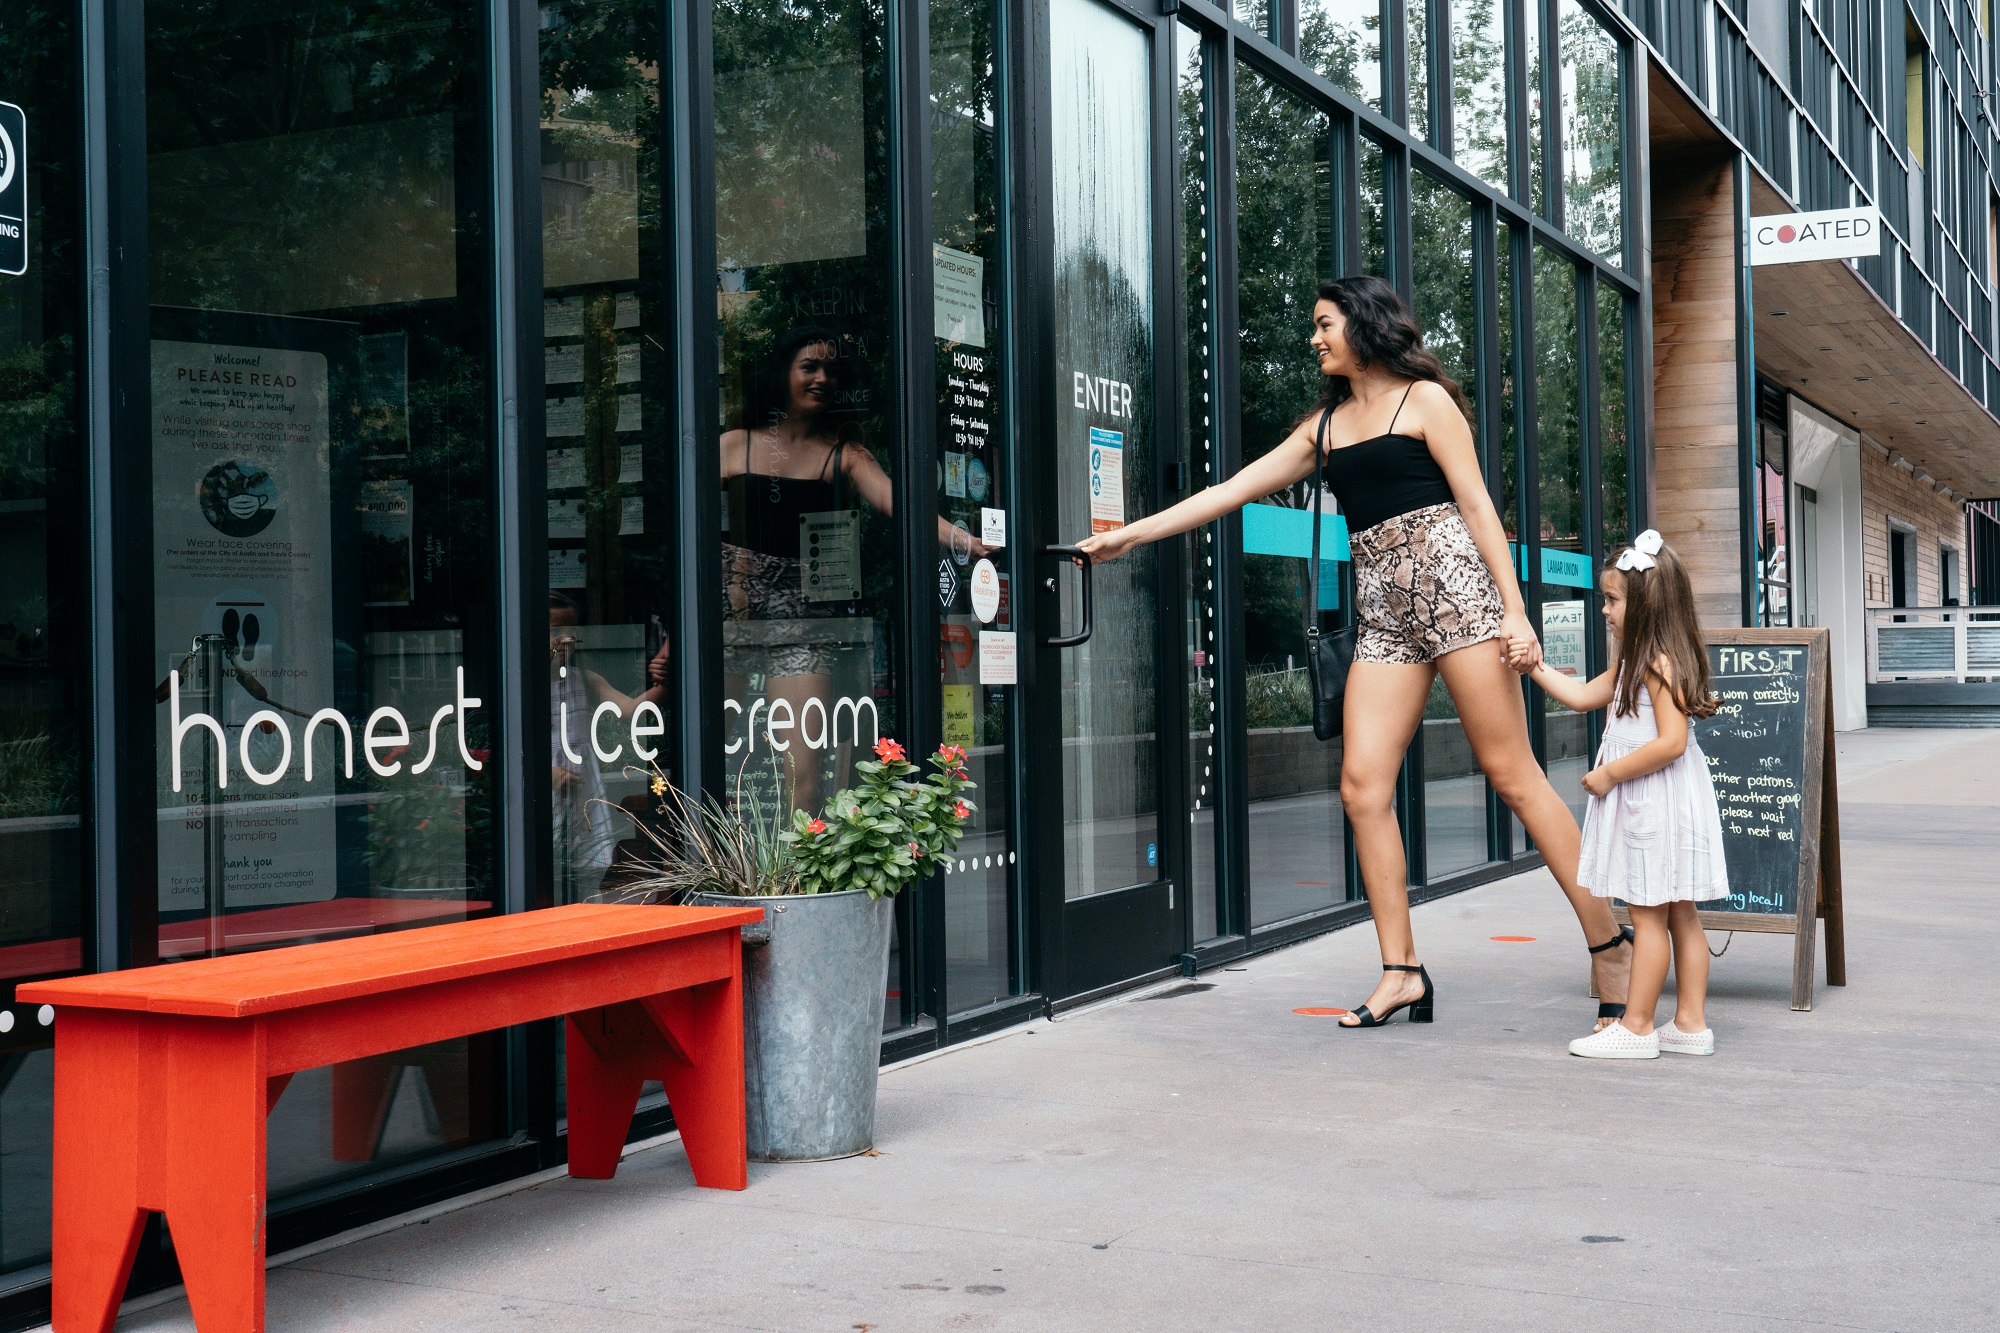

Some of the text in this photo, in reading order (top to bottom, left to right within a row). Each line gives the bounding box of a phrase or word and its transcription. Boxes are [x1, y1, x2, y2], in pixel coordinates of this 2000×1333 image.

[935, 258, 956, 272] UPDATED
[214, 354, 261, 368] Welcome!
[953, 352, 984, 373] HOURS
[178, 368, 296, 388] PLEASE READ
[948, 374, 965, 392] Sunday
[968, 378, 989, 398] Thursday
[834, 389, 871, 404] SINCE
[1073, 370, 1132, 419] ENTER
[228, 400, 245, 408] ALL
[162, 414, 311, 434] While visiting our scoop shop
[950, 413, 965, 430] Friday
[162, 426, 196, 439] during
[200, 428, 227, 438] these
[231, 430, 280, 441] uncertain
[192, 441, 208, 450] we
[211, 441, 228, 451] ask
[232, 441, 252, 452] that
[368, 501, 406, 512] 400,000
[186, 538, 292, 552] Wear face covering
[1546, 560, 1579, 577] LAMAR UNION
[1720, 648, 1803, 675] FIRST
[261, 667, 308, 682] line/rope
[1723, 686, 1800, 704] worn correctly
[170, 666, 880, 793] honest ice cream
[1712, 772, 1797, 789] other patrons.
[186, 790, 299, 803] 10 max inside
[1729, 791, 1775, 804] another
[1777, 793, 1801, 810] group
[247, 804, 298, 817] permitted
[1721, 806, 1785, 825] please wait
[187, 816, 299, 830] NO transactions
[1728, 821, 1794, 842] to next red
[230, 830, 277, 842] sampling
[253, 859, 273, 873] you
[171, 876, 184, 885] for
[242, 872, 259, 881] and
[261, 869, 314, 883] cooperation
[171, 885, 200, 896] during
[228, 881, 271, 893] temporary
[275, 878, 314, 891] changes!
[1748, 890, 1783, 911] local!
